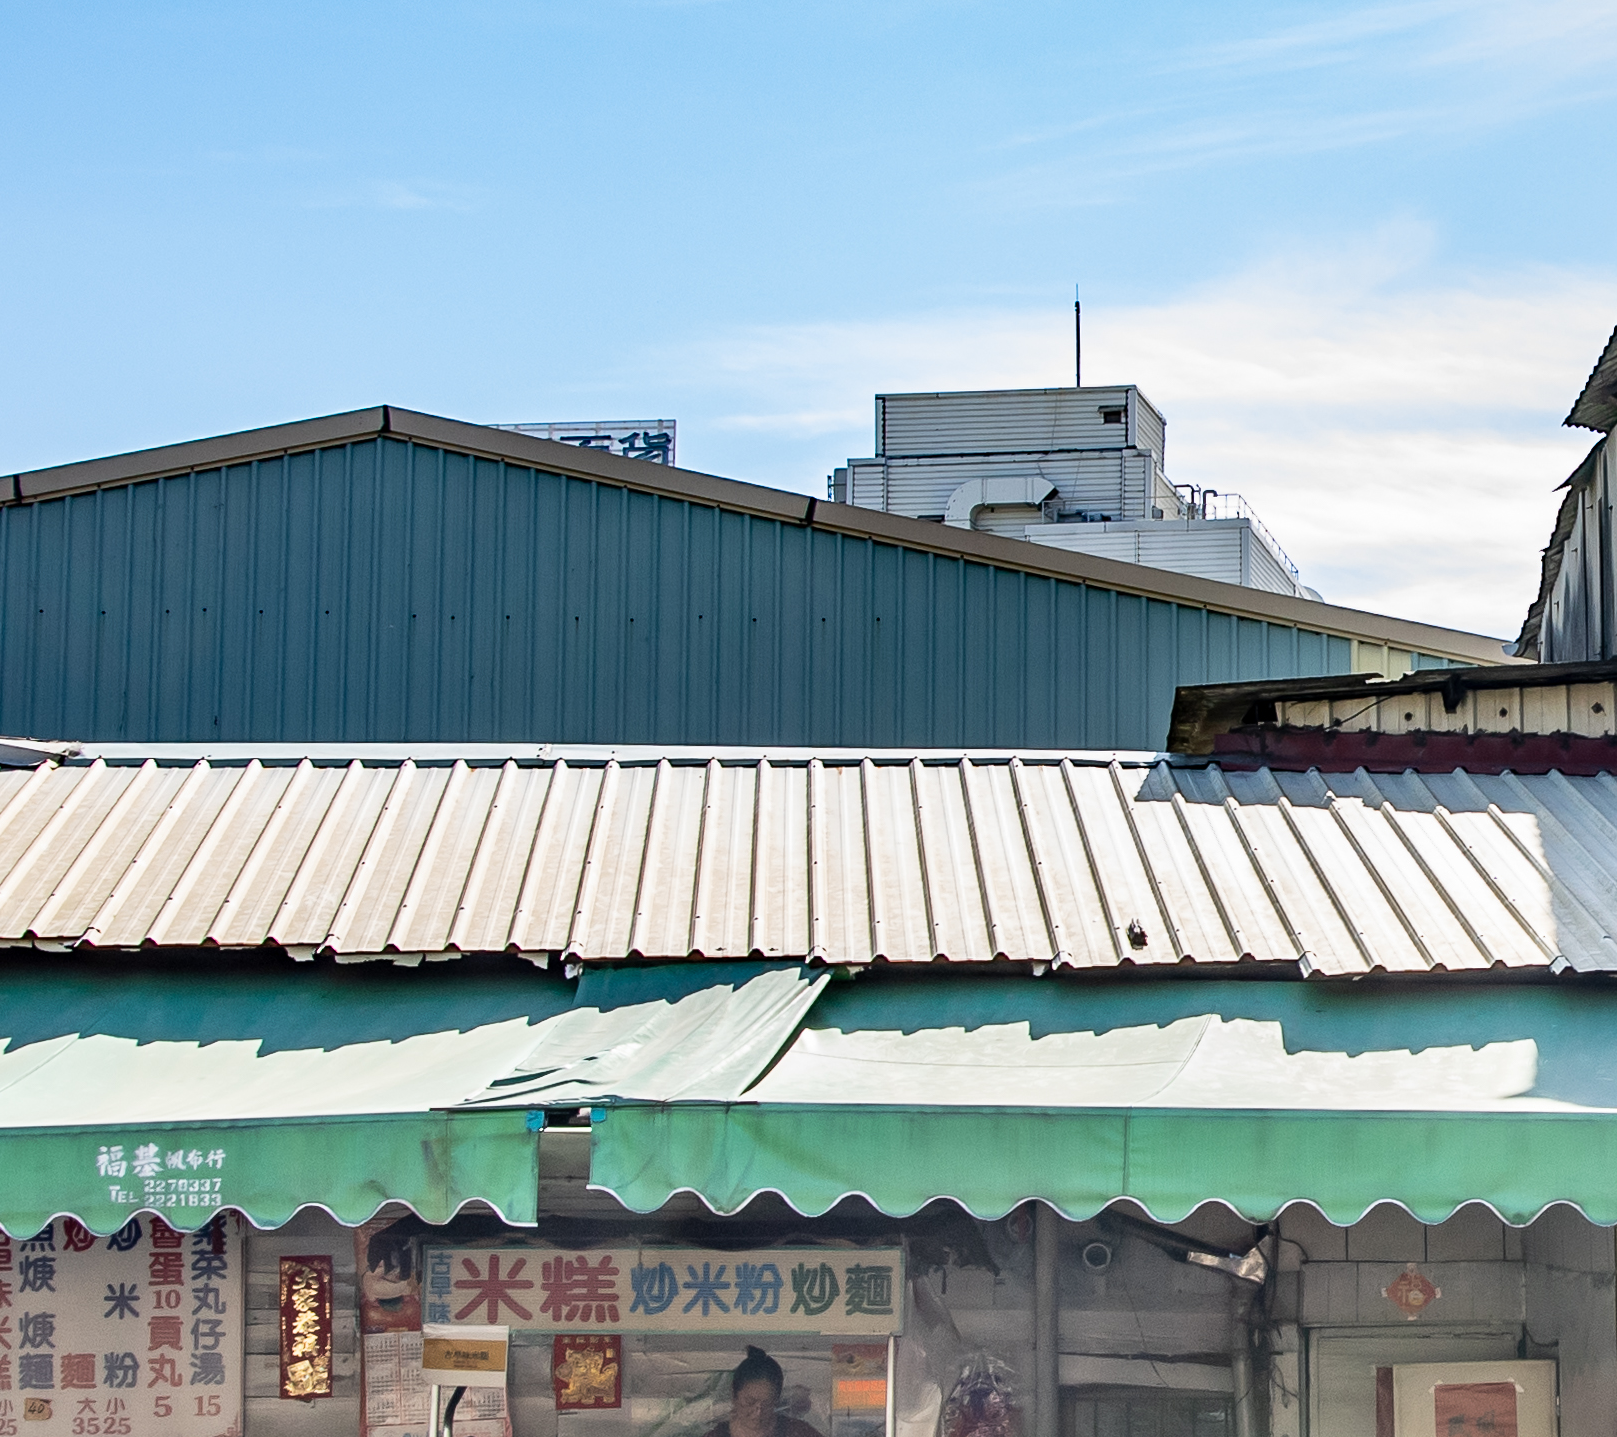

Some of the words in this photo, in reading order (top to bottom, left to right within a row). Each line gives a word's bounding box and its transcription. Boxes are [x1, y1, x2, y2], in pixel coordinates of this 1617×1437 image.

[96, 1143, 226, 1178] 福基帆布行
[153, 1289, 181, 1310] 10
[429, 1252, 453, 1325] 古早味
[453, 1254, 622, 1324] 米糕
[629, 1261, 784, 1317] 炒米粉
[789, 1263, 895, 1317] 炒麵
[147, 1316, 185, 1389] 貢丸
[154, 1396, 173, 1418] 5
[194, 1395, 222, 1417] 15
